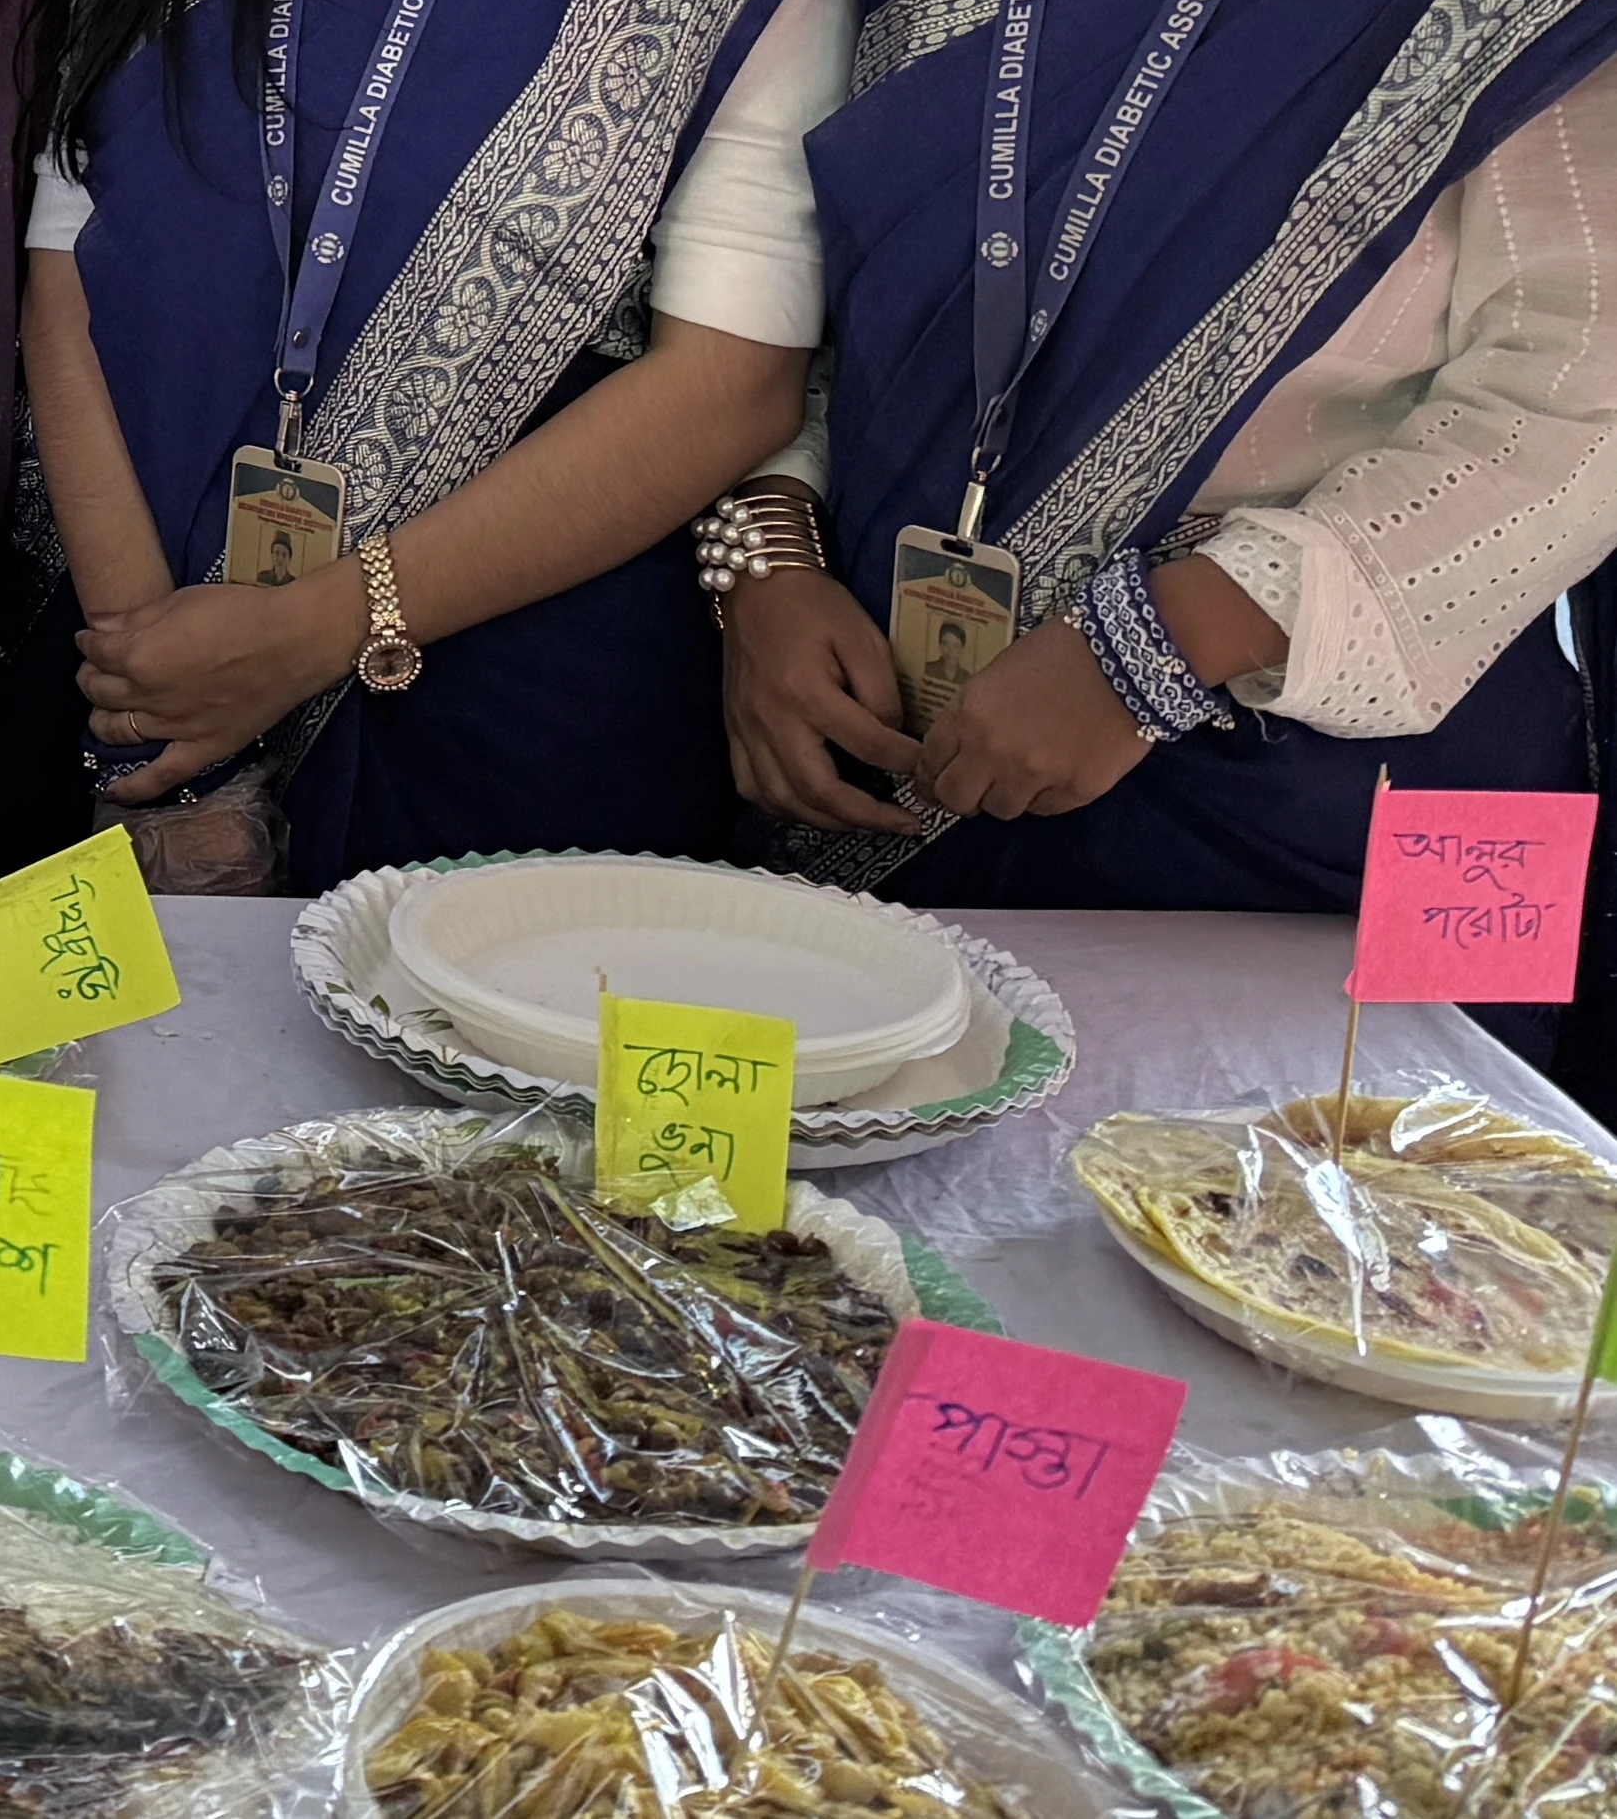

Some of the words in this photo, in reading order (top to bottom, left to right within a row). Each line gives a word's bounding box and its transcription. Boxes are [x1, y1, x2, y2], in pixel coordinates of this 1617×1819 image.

[265, 44, 288, 146] CUMILLA
[989, 85, 1021, 200] CUMILLA
[331, 105, 381, 206] CUMILLA
[1049, 171, 1111, 282] CUMILLA
[1094, 51, 1172, 168] DIABETIC
[1393, 833, 1545, 891] আলুর
[40, 874, 120, 1000] খিচুড়ি
[623, 1043, 778, 1107] ছোলা
[638, 1122, 734, 1189] ভুনা
[905, 1392, 1117, 1501] পাস্তা
